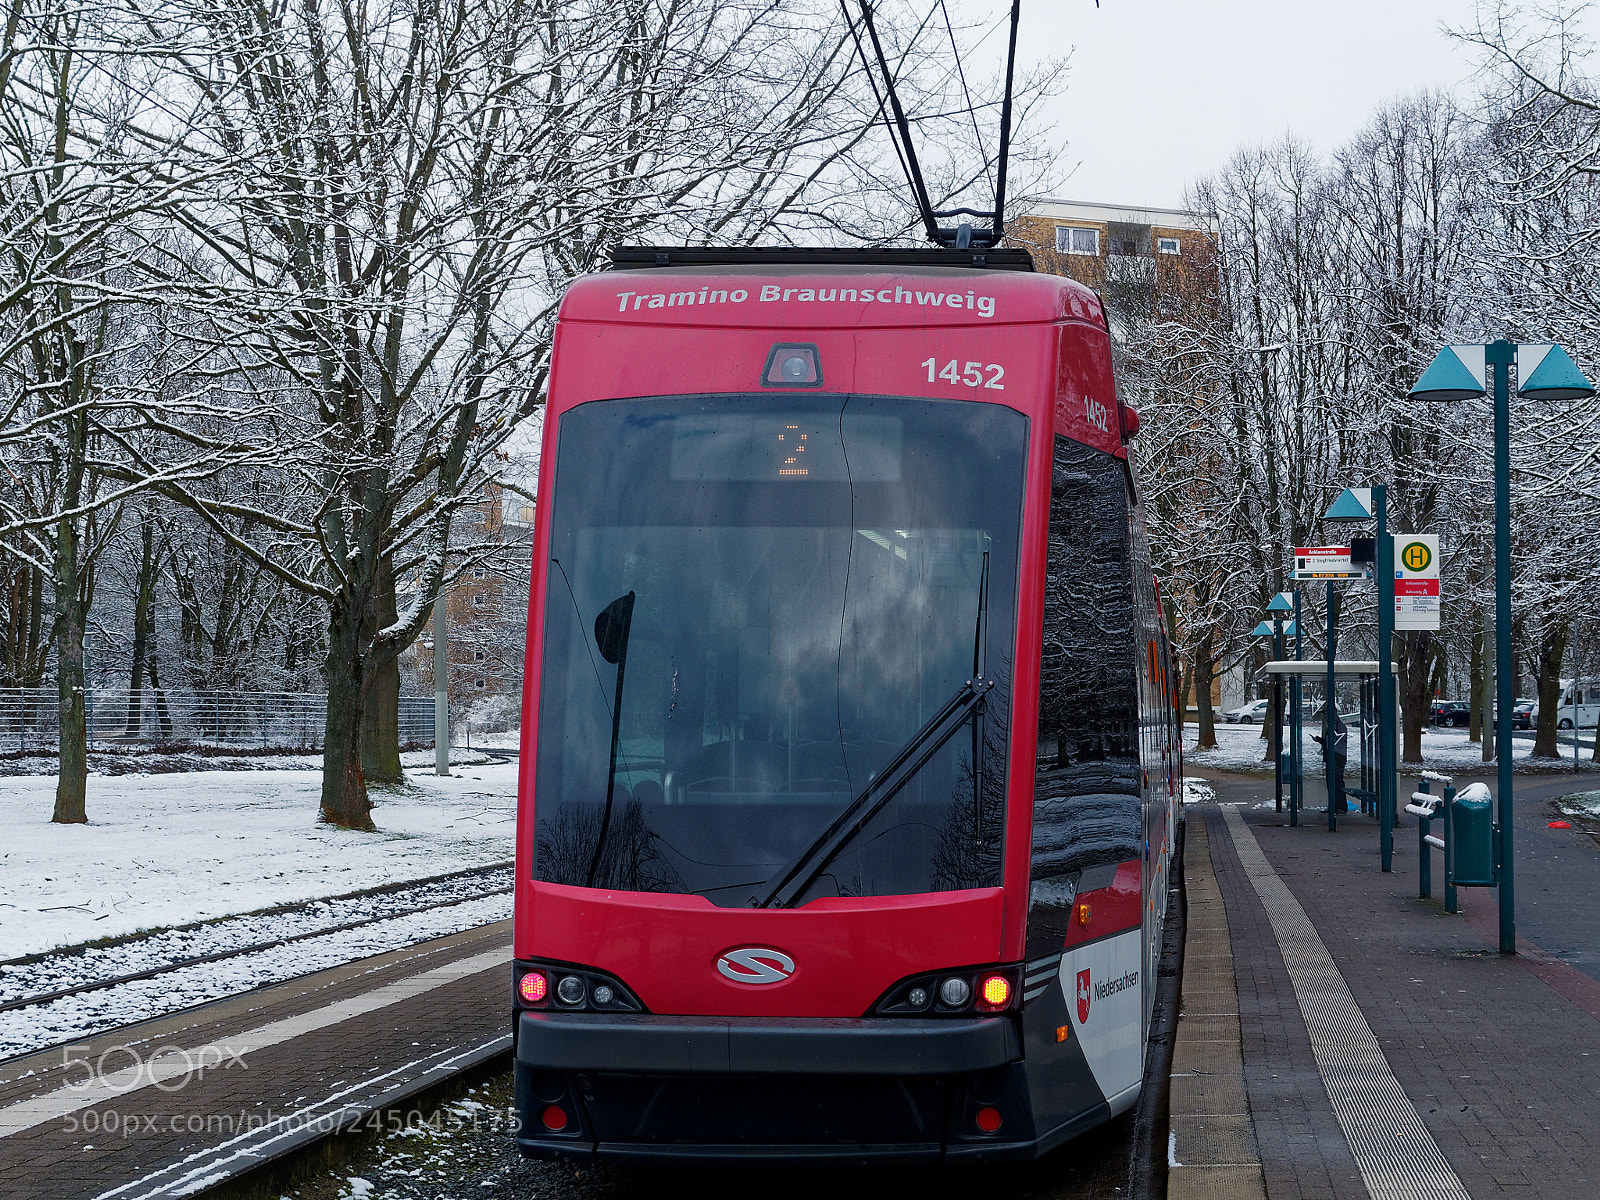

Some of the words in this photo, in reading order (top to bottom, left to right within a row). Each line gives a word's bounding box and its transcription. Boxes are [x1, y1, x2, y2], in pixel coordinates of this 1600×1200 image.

[617, 286, 749, 312] Tramino
[759, 285, 996, 318] Braunschweig
[921, 357, 1005, 390] 1452
[1084, 394, 1108, 433] 1452
[778, 425, 809, 476] 2
[1410, 548, 1423, 566] H
[1094, 970, 1139, 1002] Niedersachsen
